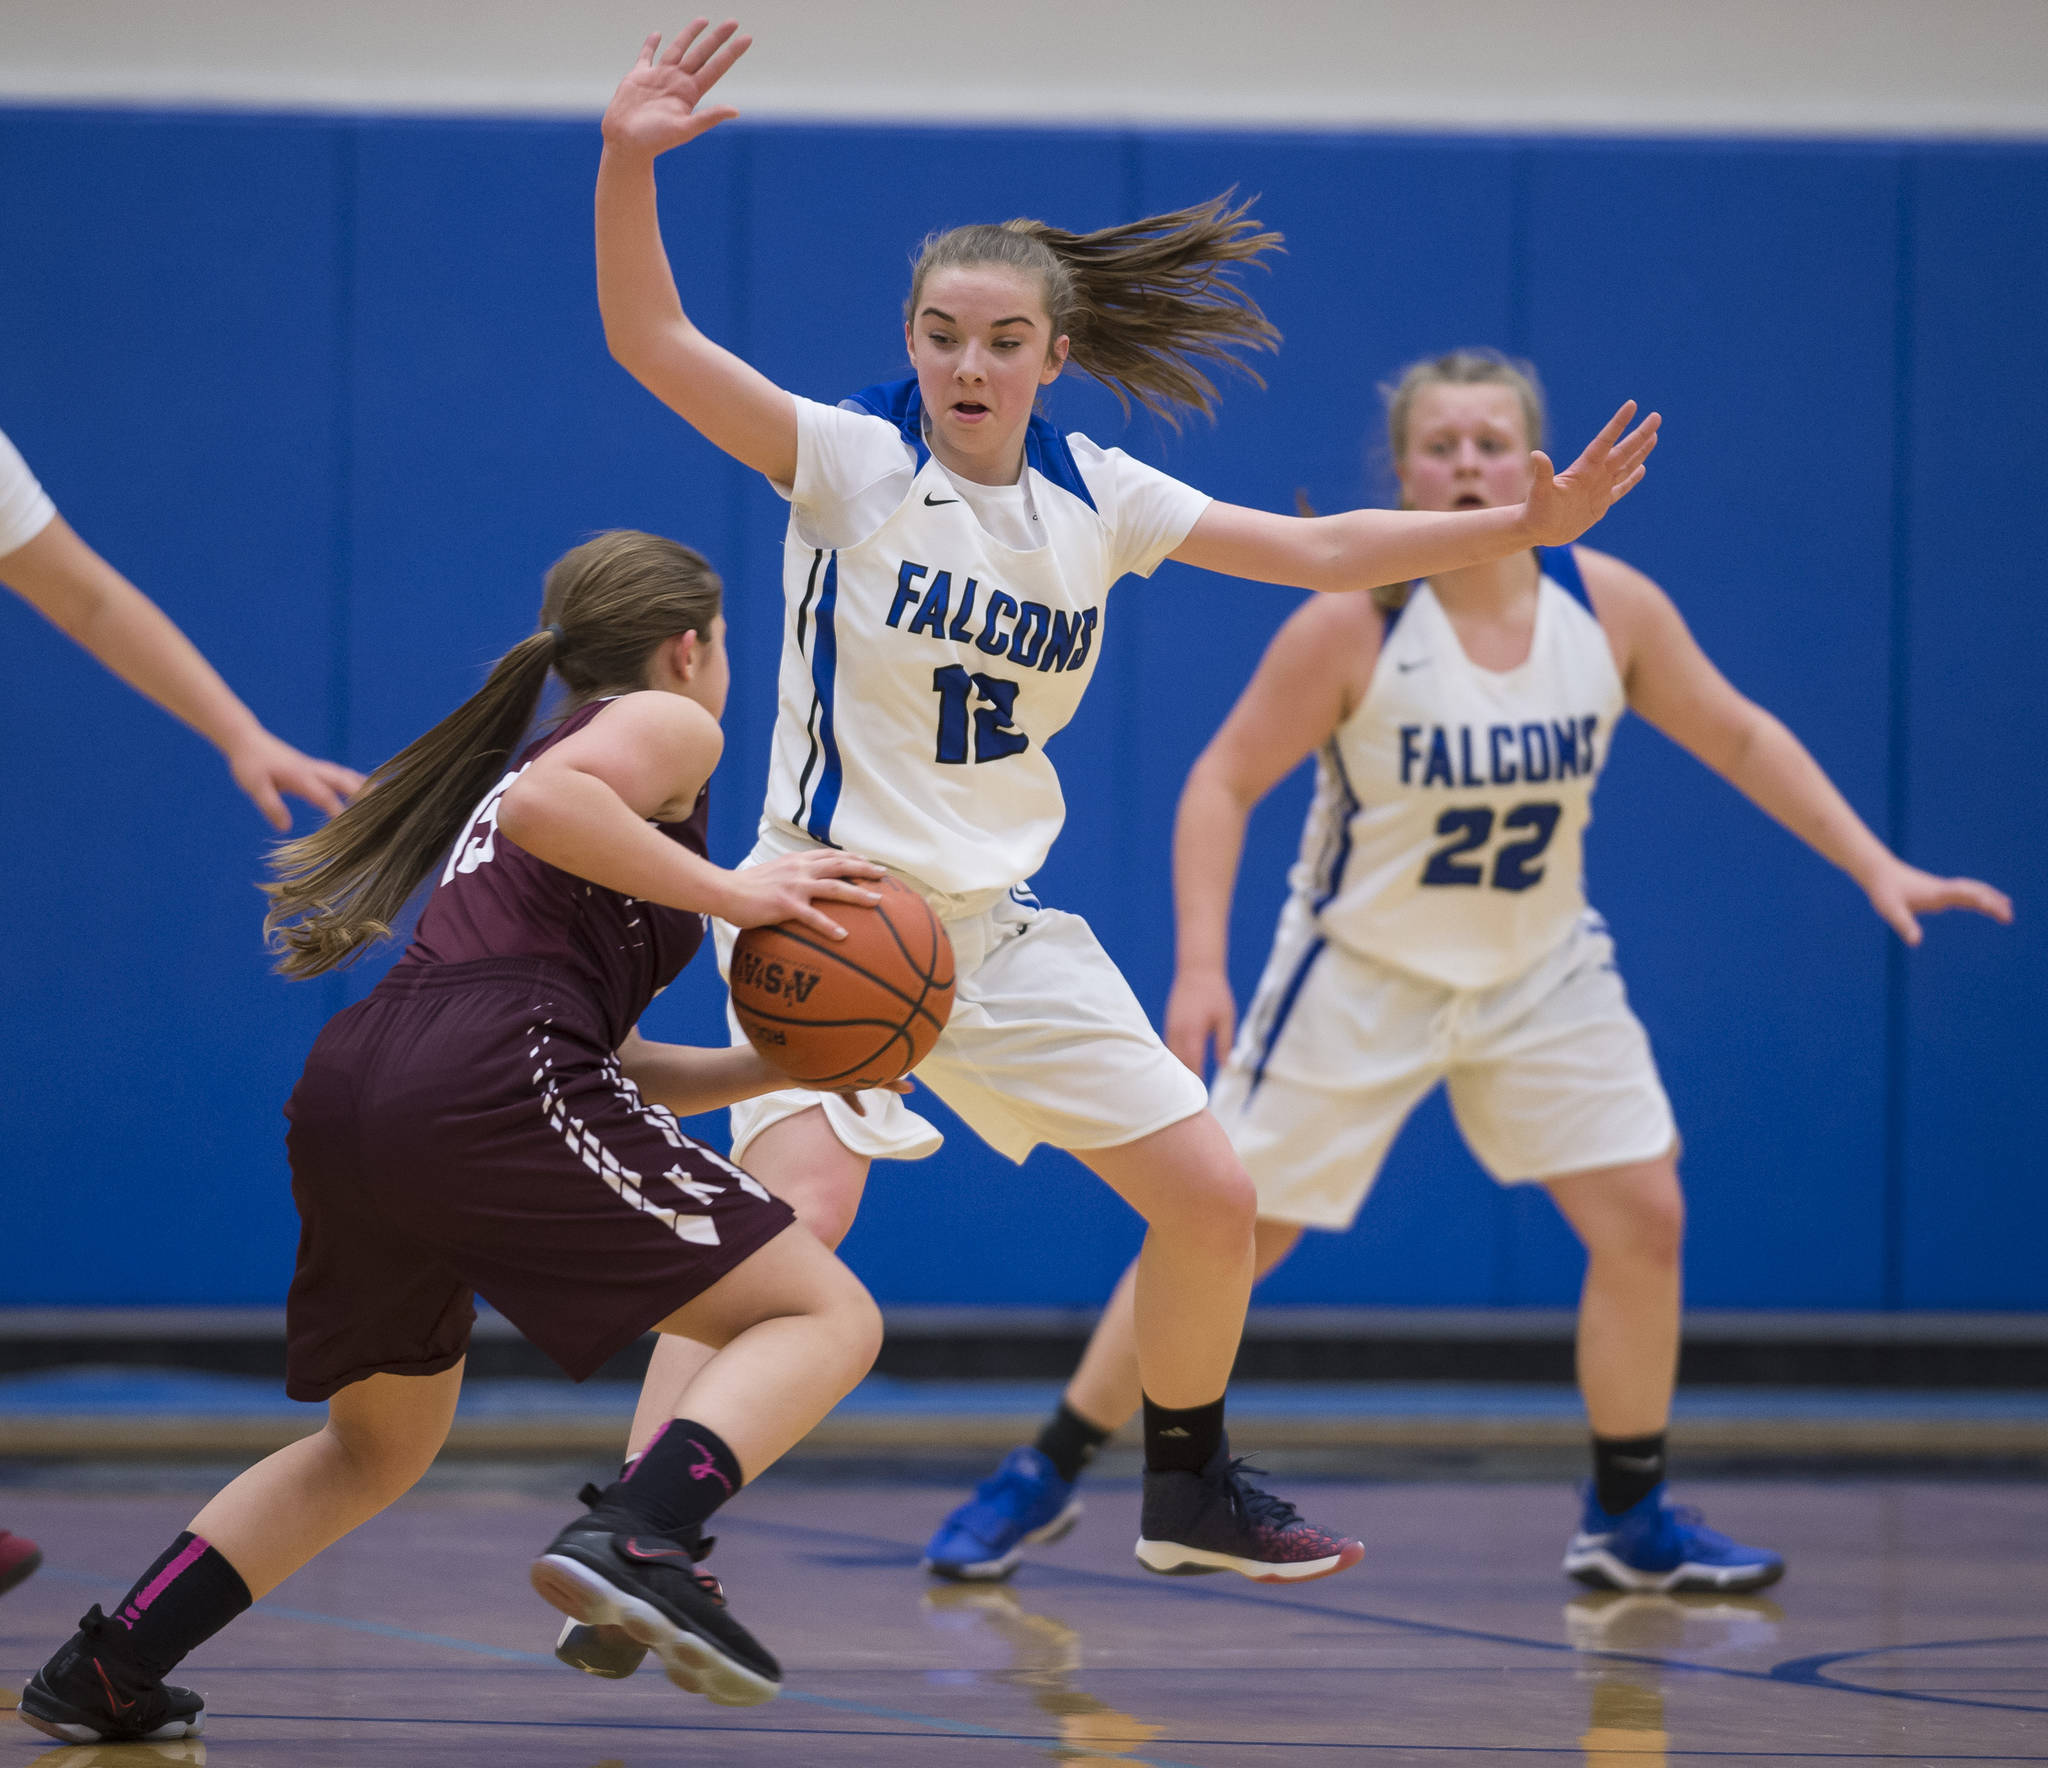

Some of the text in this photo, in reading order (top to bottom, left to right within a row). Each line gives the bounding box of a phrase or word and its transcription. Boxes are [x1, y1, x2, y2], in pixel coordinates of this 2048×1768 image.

[885, 560, 1098, 673] FALCONS
[932, 664, 1030, 764] 12
[1398, 714, 1598, 788] FALCONS
[1418, 801, 1562, 893] 22
